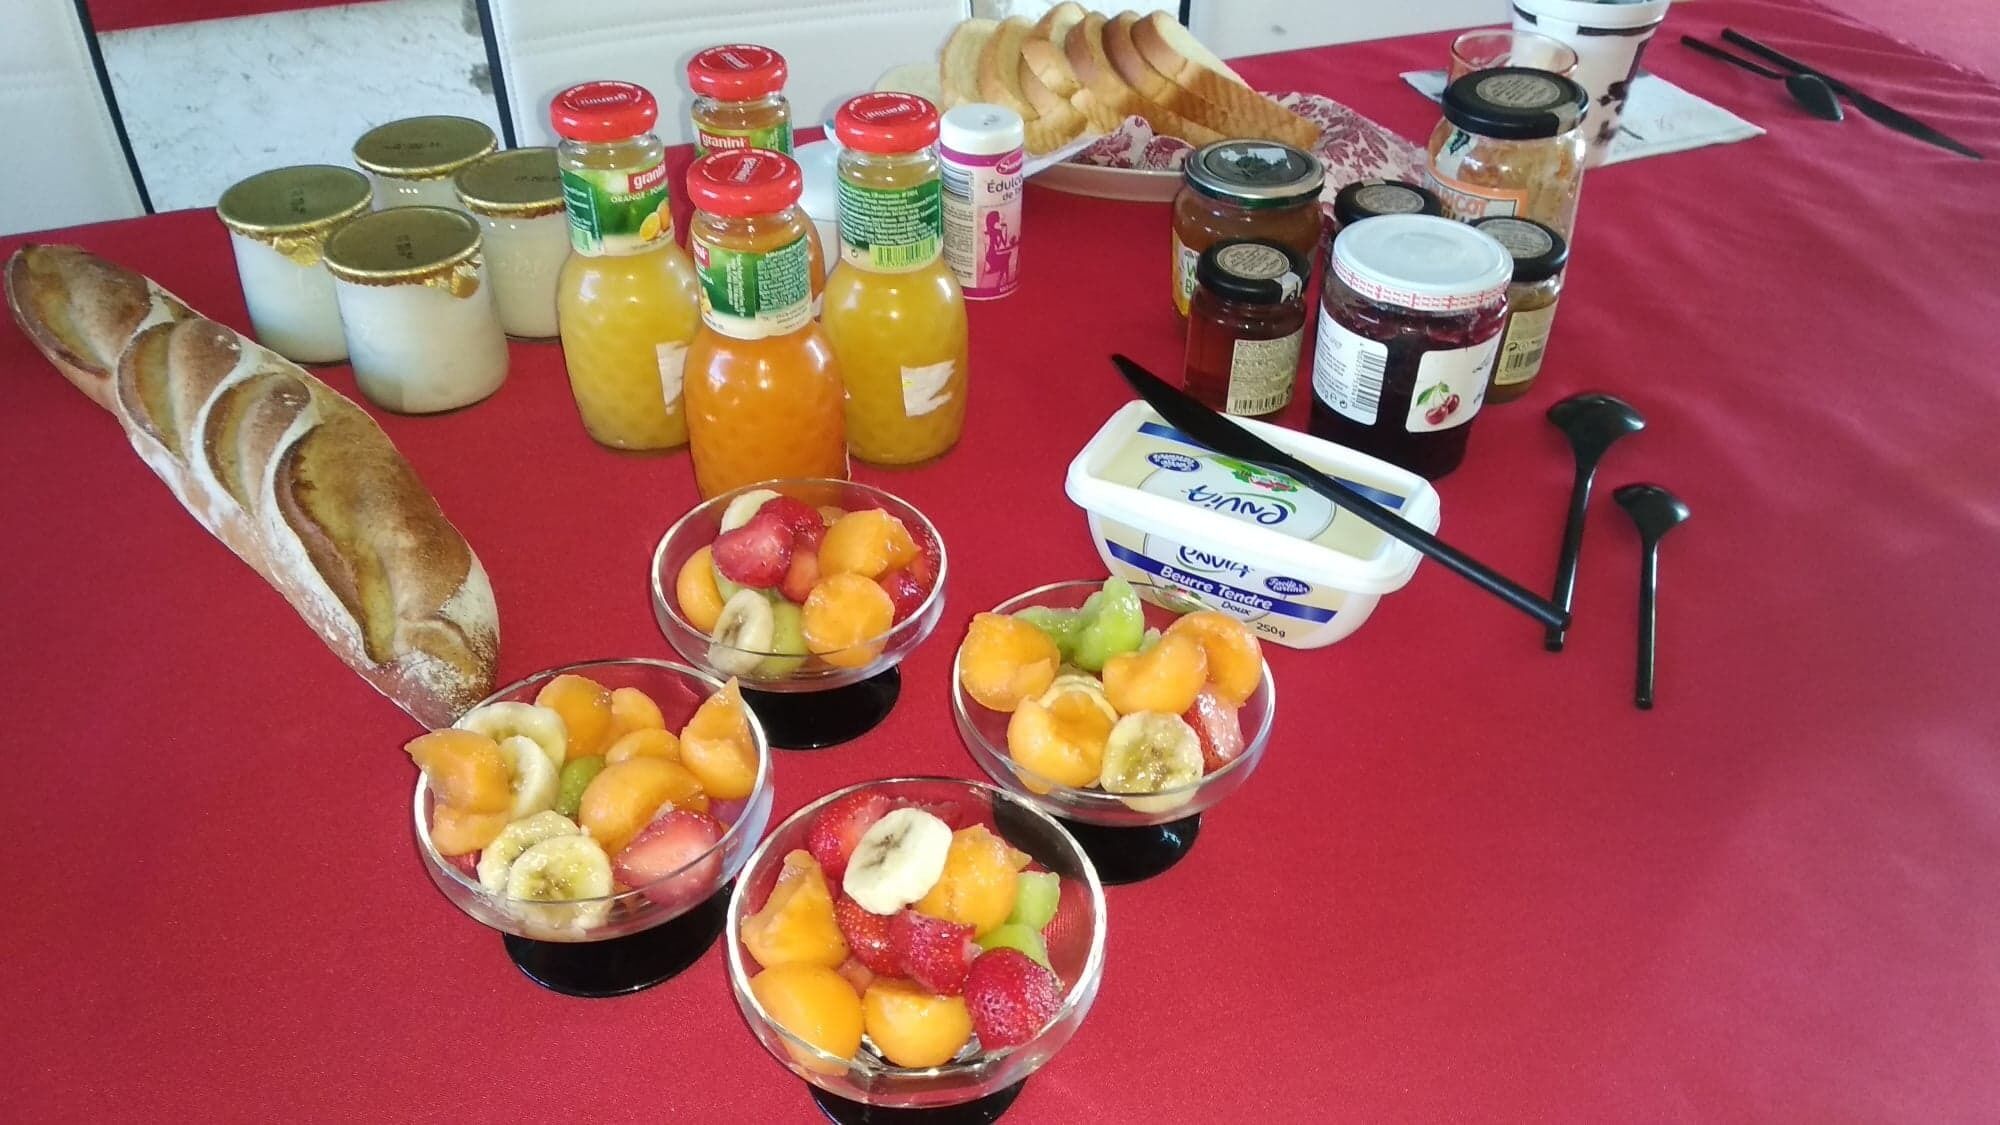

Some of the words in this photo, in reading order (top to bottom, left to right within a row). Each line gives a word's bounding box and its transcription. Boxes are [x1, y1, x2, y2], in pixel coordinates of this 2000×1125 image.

[701, 132, 745, 149] granini
[1160, 564, 1214, 593] Beurre
[1217, 583, 1273, 610] Tendre
[1221, 600, 1252, 617] Doux
[1256, 622, 1287, 638] 250g
